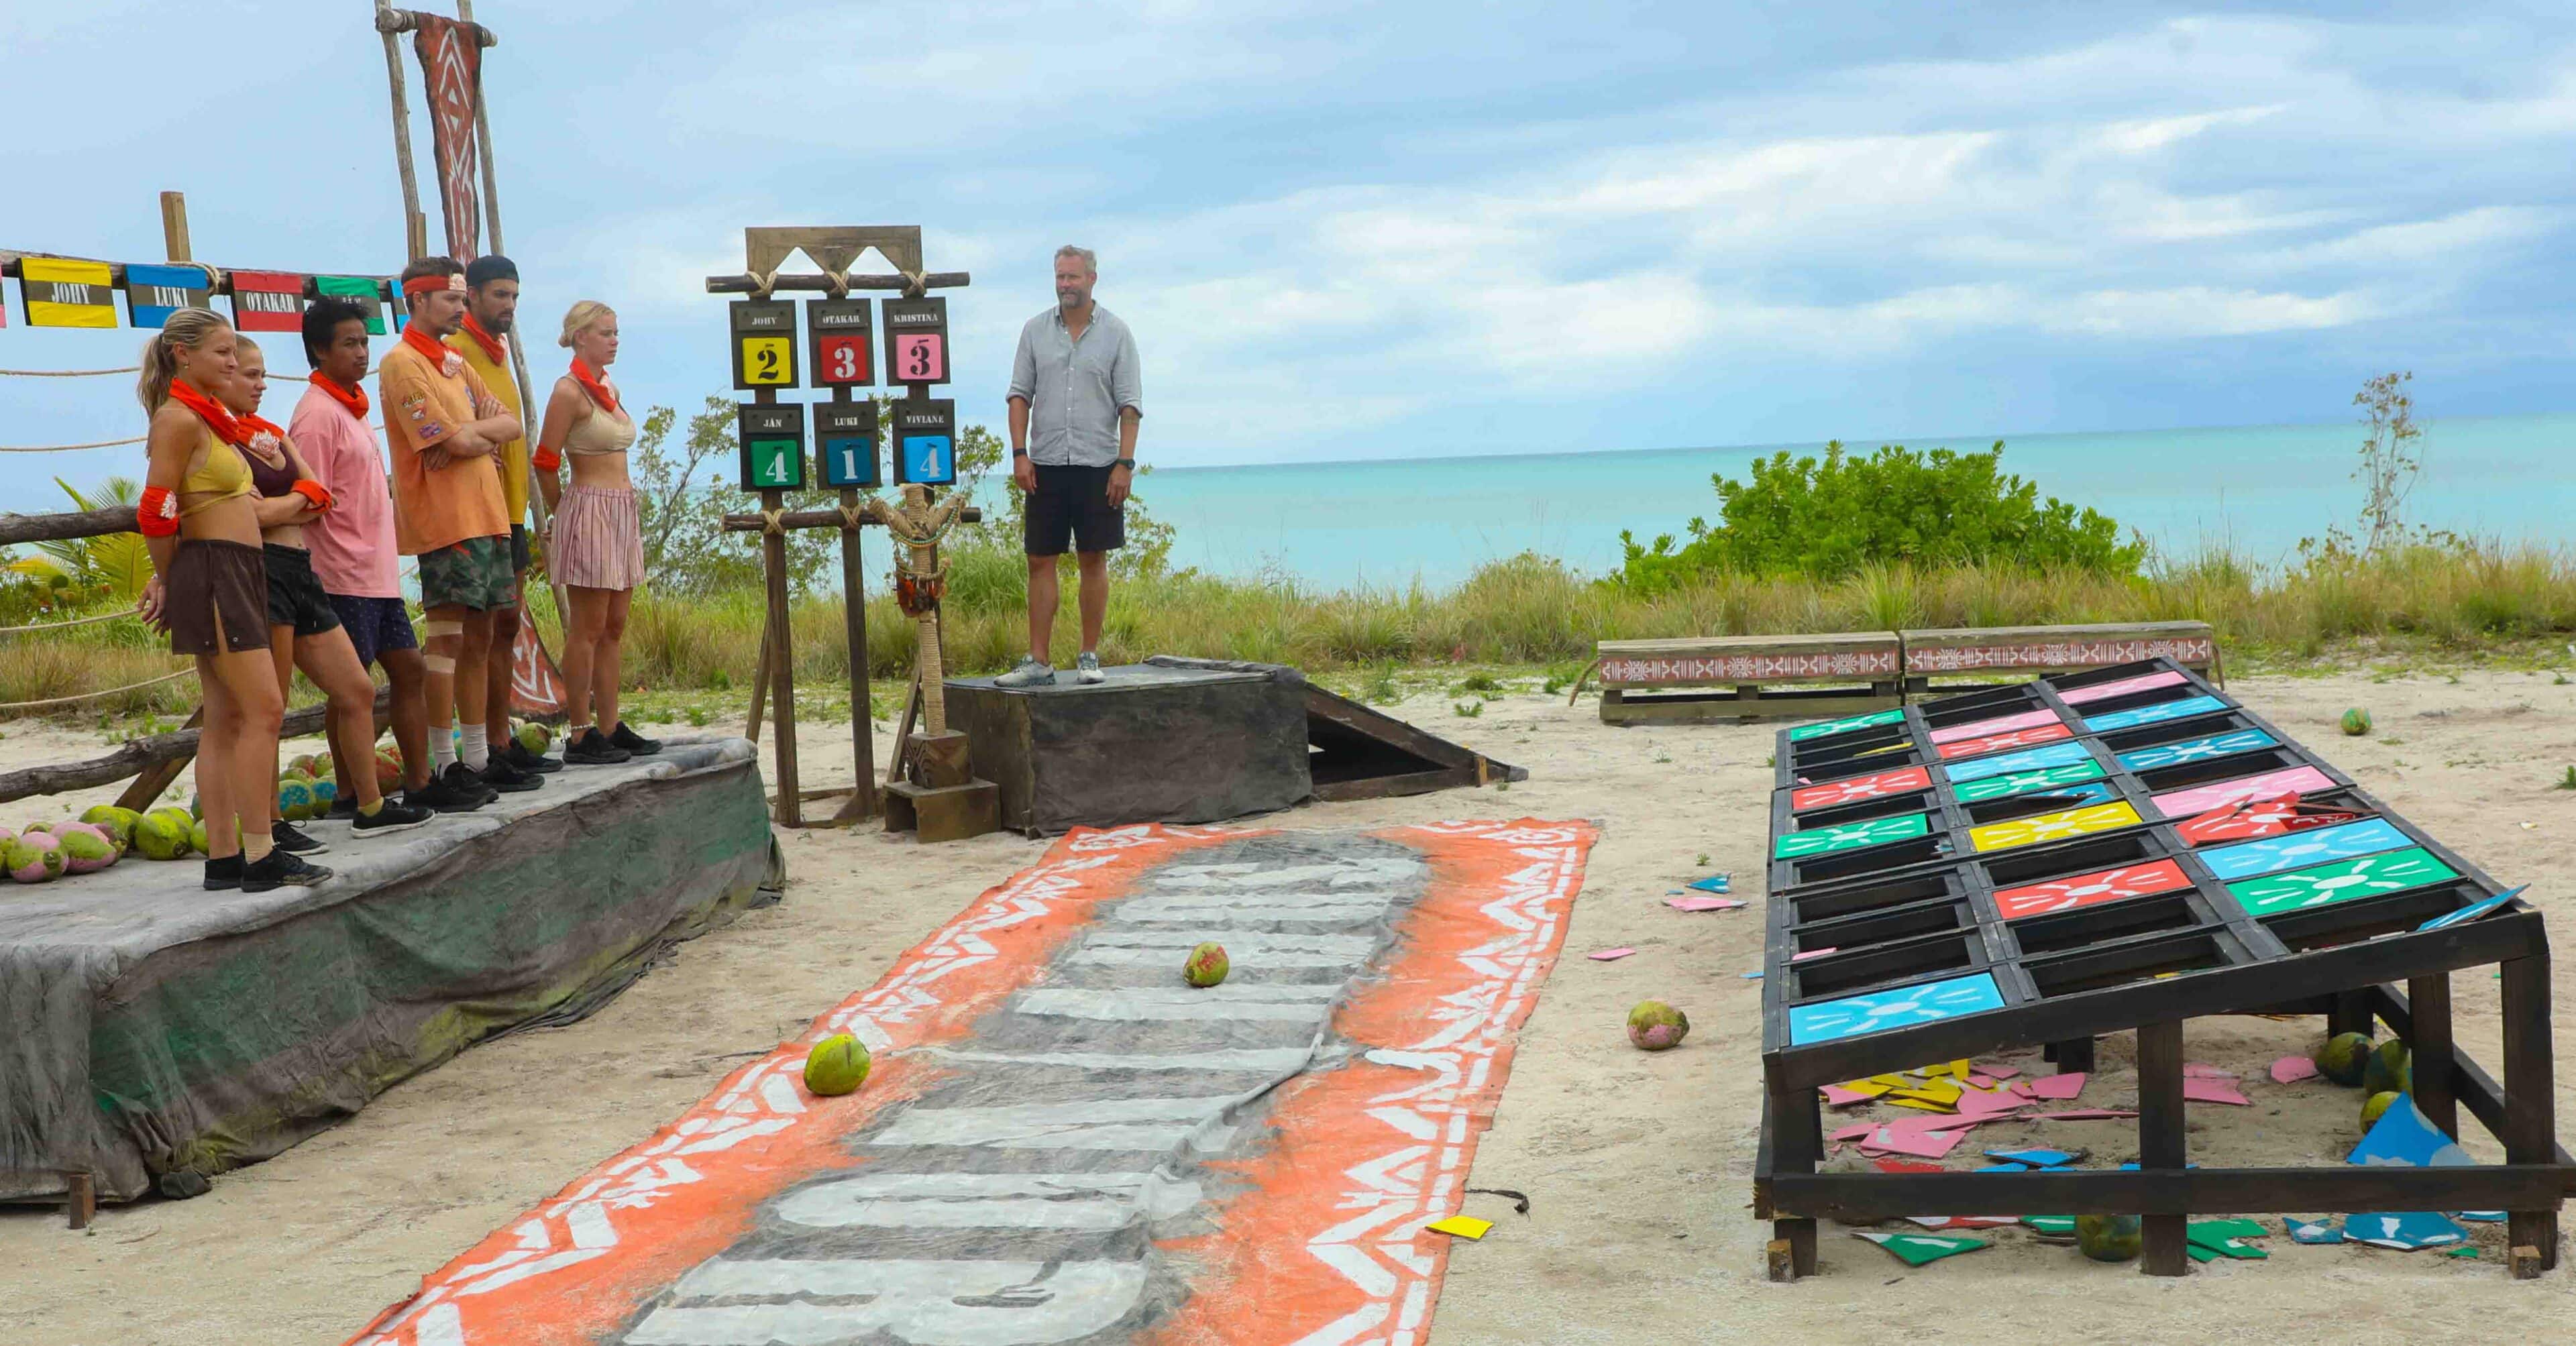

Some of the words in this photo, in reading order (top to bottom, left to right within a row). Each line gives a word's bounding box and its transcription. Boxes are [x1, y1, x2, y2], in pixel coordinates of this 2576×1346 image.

[51, 284, 91, 304] JOHY
[154, 286, 189, 307] LUKI
[246, 292, 295, 313] OTAKAR
[751, 317, 777, 325] JOHY
[822, 315, 859, 324] OTAKAR
[894, 313, 938, 323] KRISTINA
[757, 349, 779, 380] 2
[835, 347, 856, 378] 3
[910, 345, 930, 376] 3
[835, 418, 858, 426] LUKI
[906, 416, 945, 424] VIVIANE
[765, 451, 788, 482] 4
[842, 450, 858, 480] 1
[920, 448, 941, 478] 4
